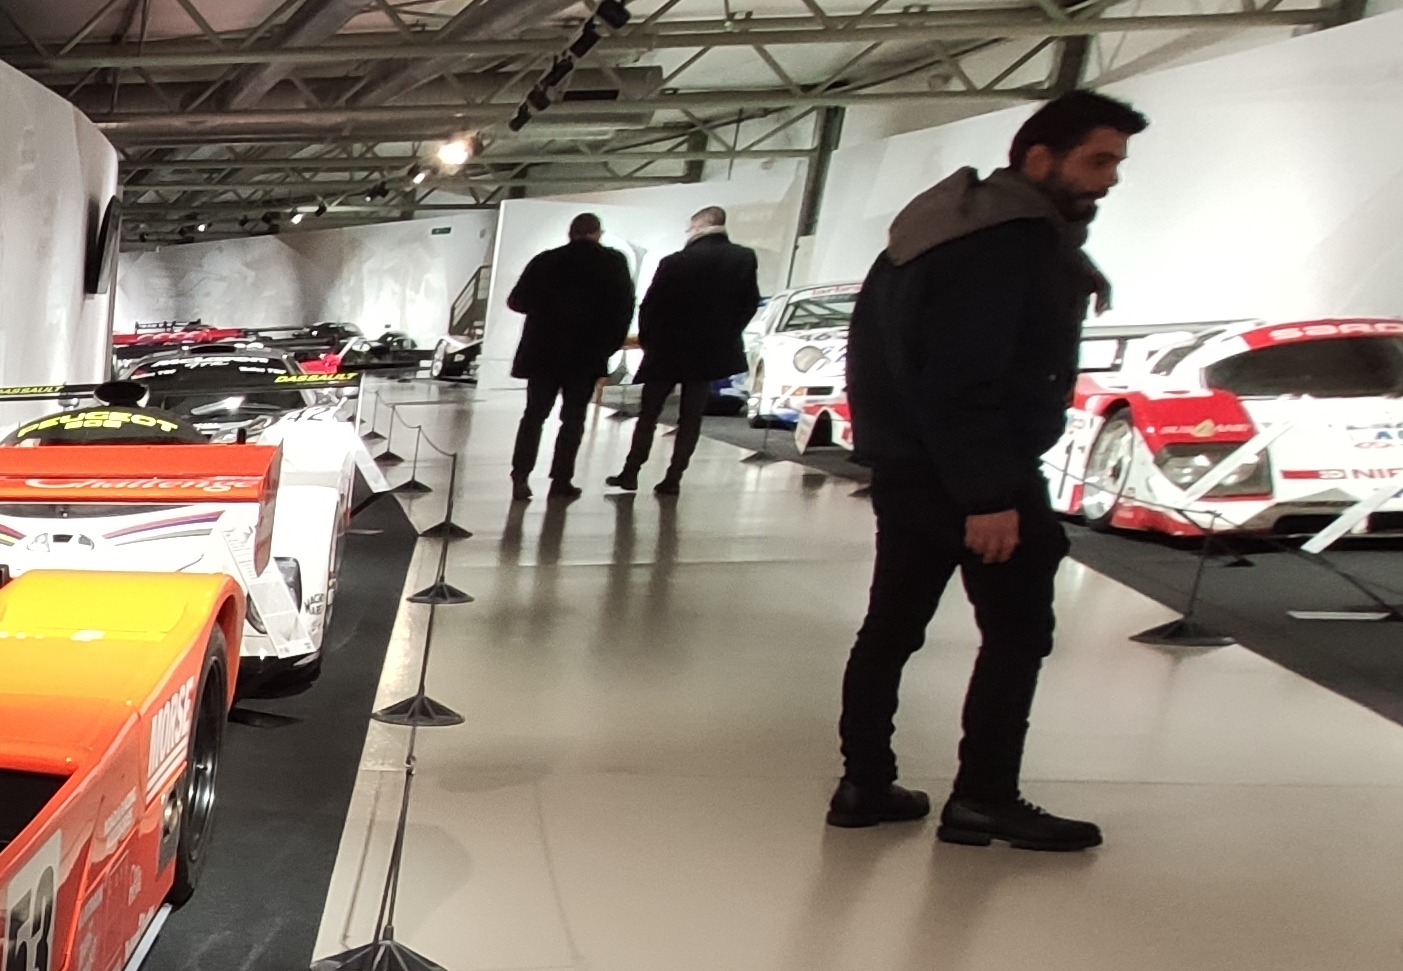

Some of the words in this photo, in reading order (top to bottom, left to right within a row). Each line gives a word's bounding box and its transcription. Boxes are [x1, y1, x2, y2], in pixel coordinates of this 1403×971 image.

[274, 372, 359, 384] DASSAULT
[17, 411, 179, 438] PEUGEOT
[24, 477, 259, 493] Challenge
